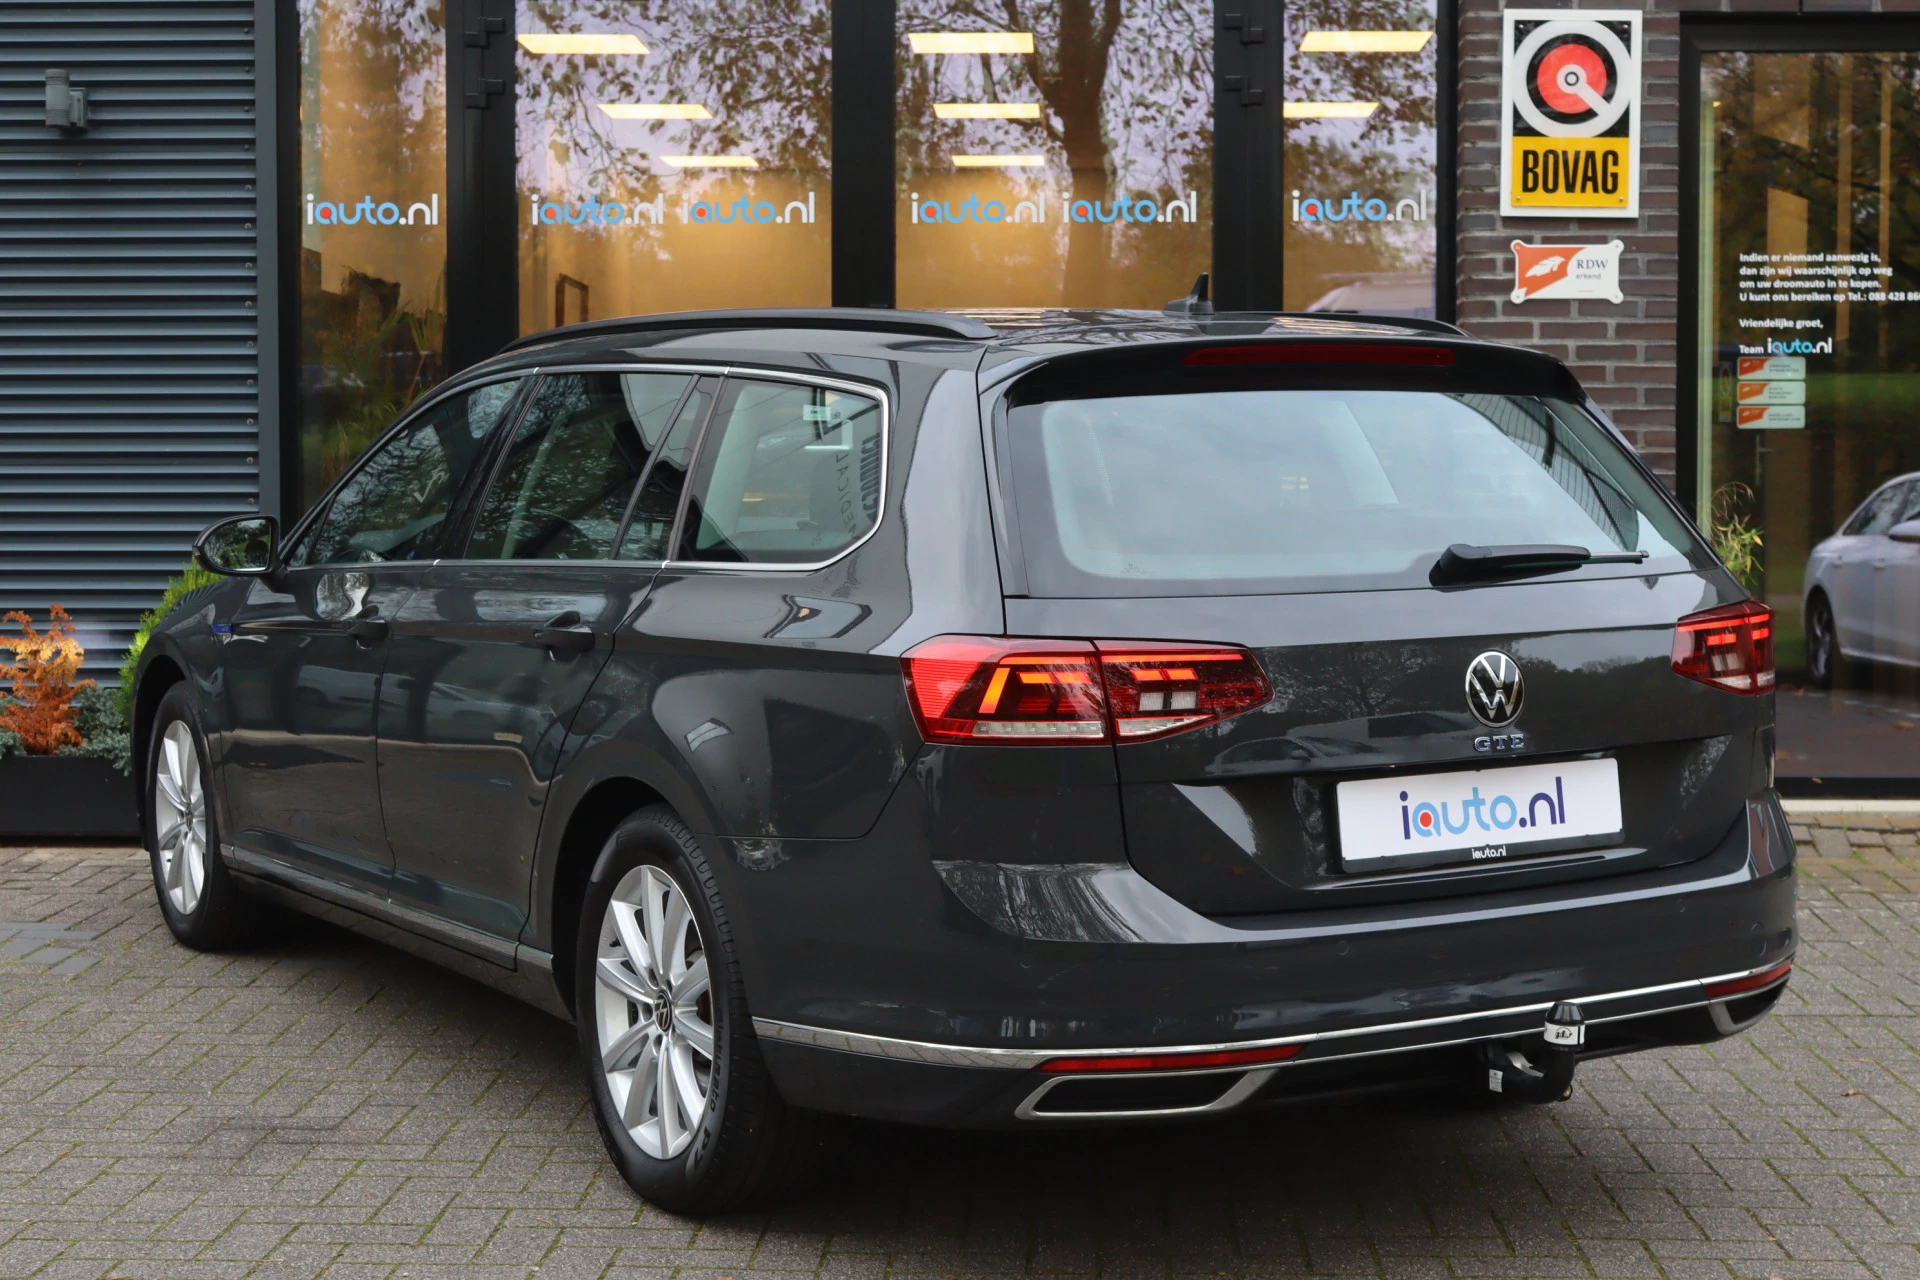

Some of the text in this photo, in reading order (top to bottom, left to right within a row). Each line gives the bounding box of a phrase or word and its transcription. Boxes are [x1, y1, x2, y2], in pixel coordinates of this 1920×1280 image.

[1522, 149, 1619, 194] BOVAG
[306, 193, 438, 225] iauto.nl
[531, 193, 664, 225] iauto.nl
[682, 192, 815, 224] iauto.nl
[911, 192, 1045, 223] iauto.nl
[1062, 191, 1197, 223] iauto.nl
[1291, 190, 1427, 222] iauto.nl
[1576, 259, 1608, 269] RDW
[1739, 253, 1769, 262] Indien
[1783, 253, 1824, 262] niemand
[1826, 253, 1869, 264] aanwezig
[1870, 253, 1881, 263] is,
[1739, 266, 1893, 277] dan zijn wij waarschijnlijk op weg
[1773, 279, 1825, 288] droomauto
[1827, 279, 1837, 288] in
[1838, 280, 1848, 288] te
[1850, 279, 1881, 289] kopen.
[1739, 292, 1748, 301] U
[1750, 291, 1770, 301] kunt
[1791, 292, 1831, 301] bereiken
[1833, 294, 1845, 303] op
[1848, 292, 1866, 301] Tel.:
[1868, 292, 1886, 301] 088
[1888, 292, 1905, 301] 428
[1739, 318, 1823, 329] Vriendelijke groet,
[1739, 337, 1832, 353] Team iauto.nl
[1474, 733, 1525, 752] GTE
[1400, 776, 1565, 840] iauto.nl
[1472, 845, 1507, 860] iauto.nl
